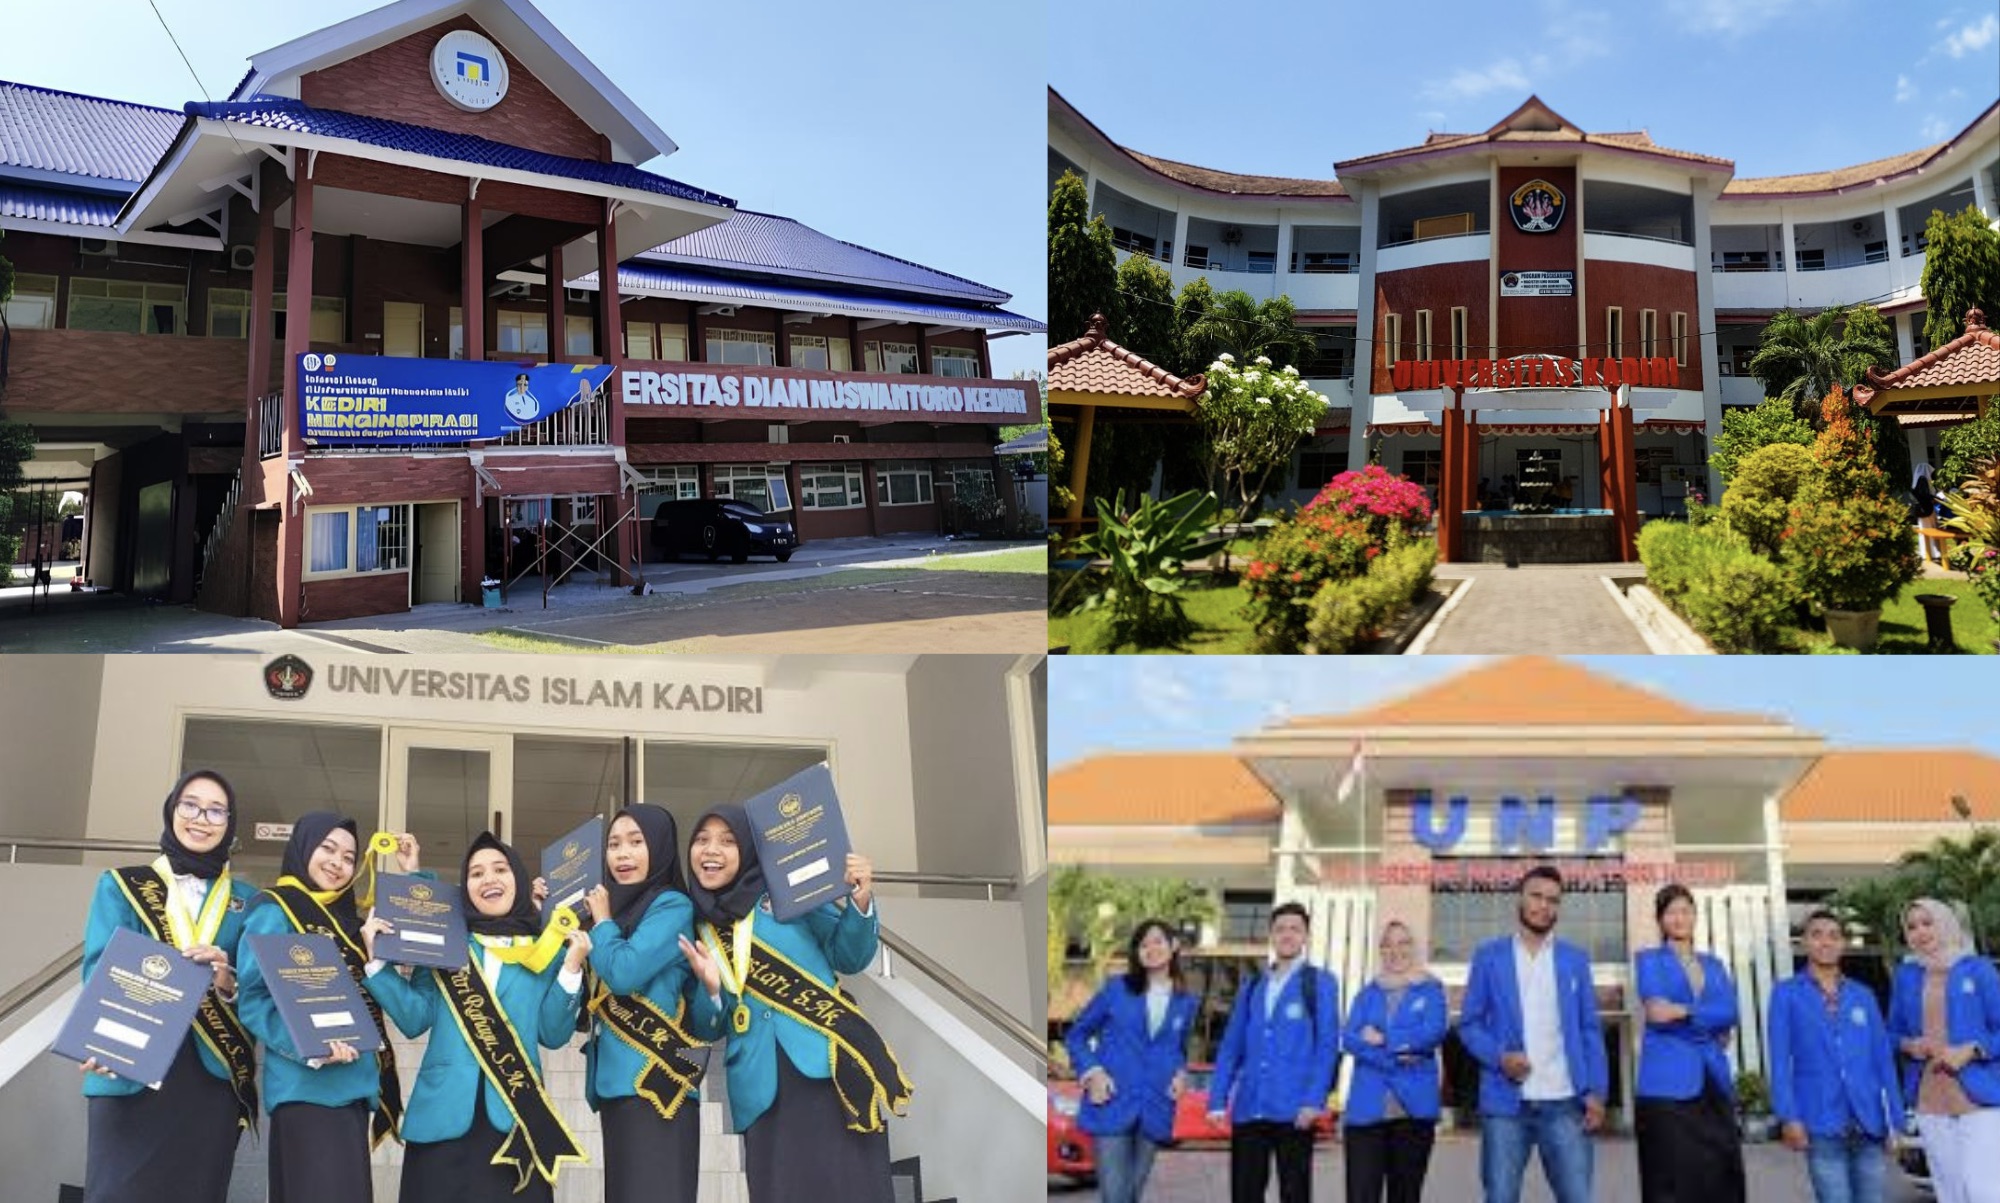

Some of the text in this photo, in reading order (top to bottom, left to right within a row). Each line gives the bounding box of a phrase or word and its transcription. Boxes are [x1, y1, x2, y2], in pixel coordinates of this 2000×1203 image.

[743, 376, 811, 408] DIAN
[810, 379, 963, 412] NUSWANTORO
[1393, 356, 1680, 389] UNIVERSITAS KADIRI
[327, 664, 764, 715] UNIVERSITAS ISLAM KADIRI
[1410, 795, 1644, 850] UNP
